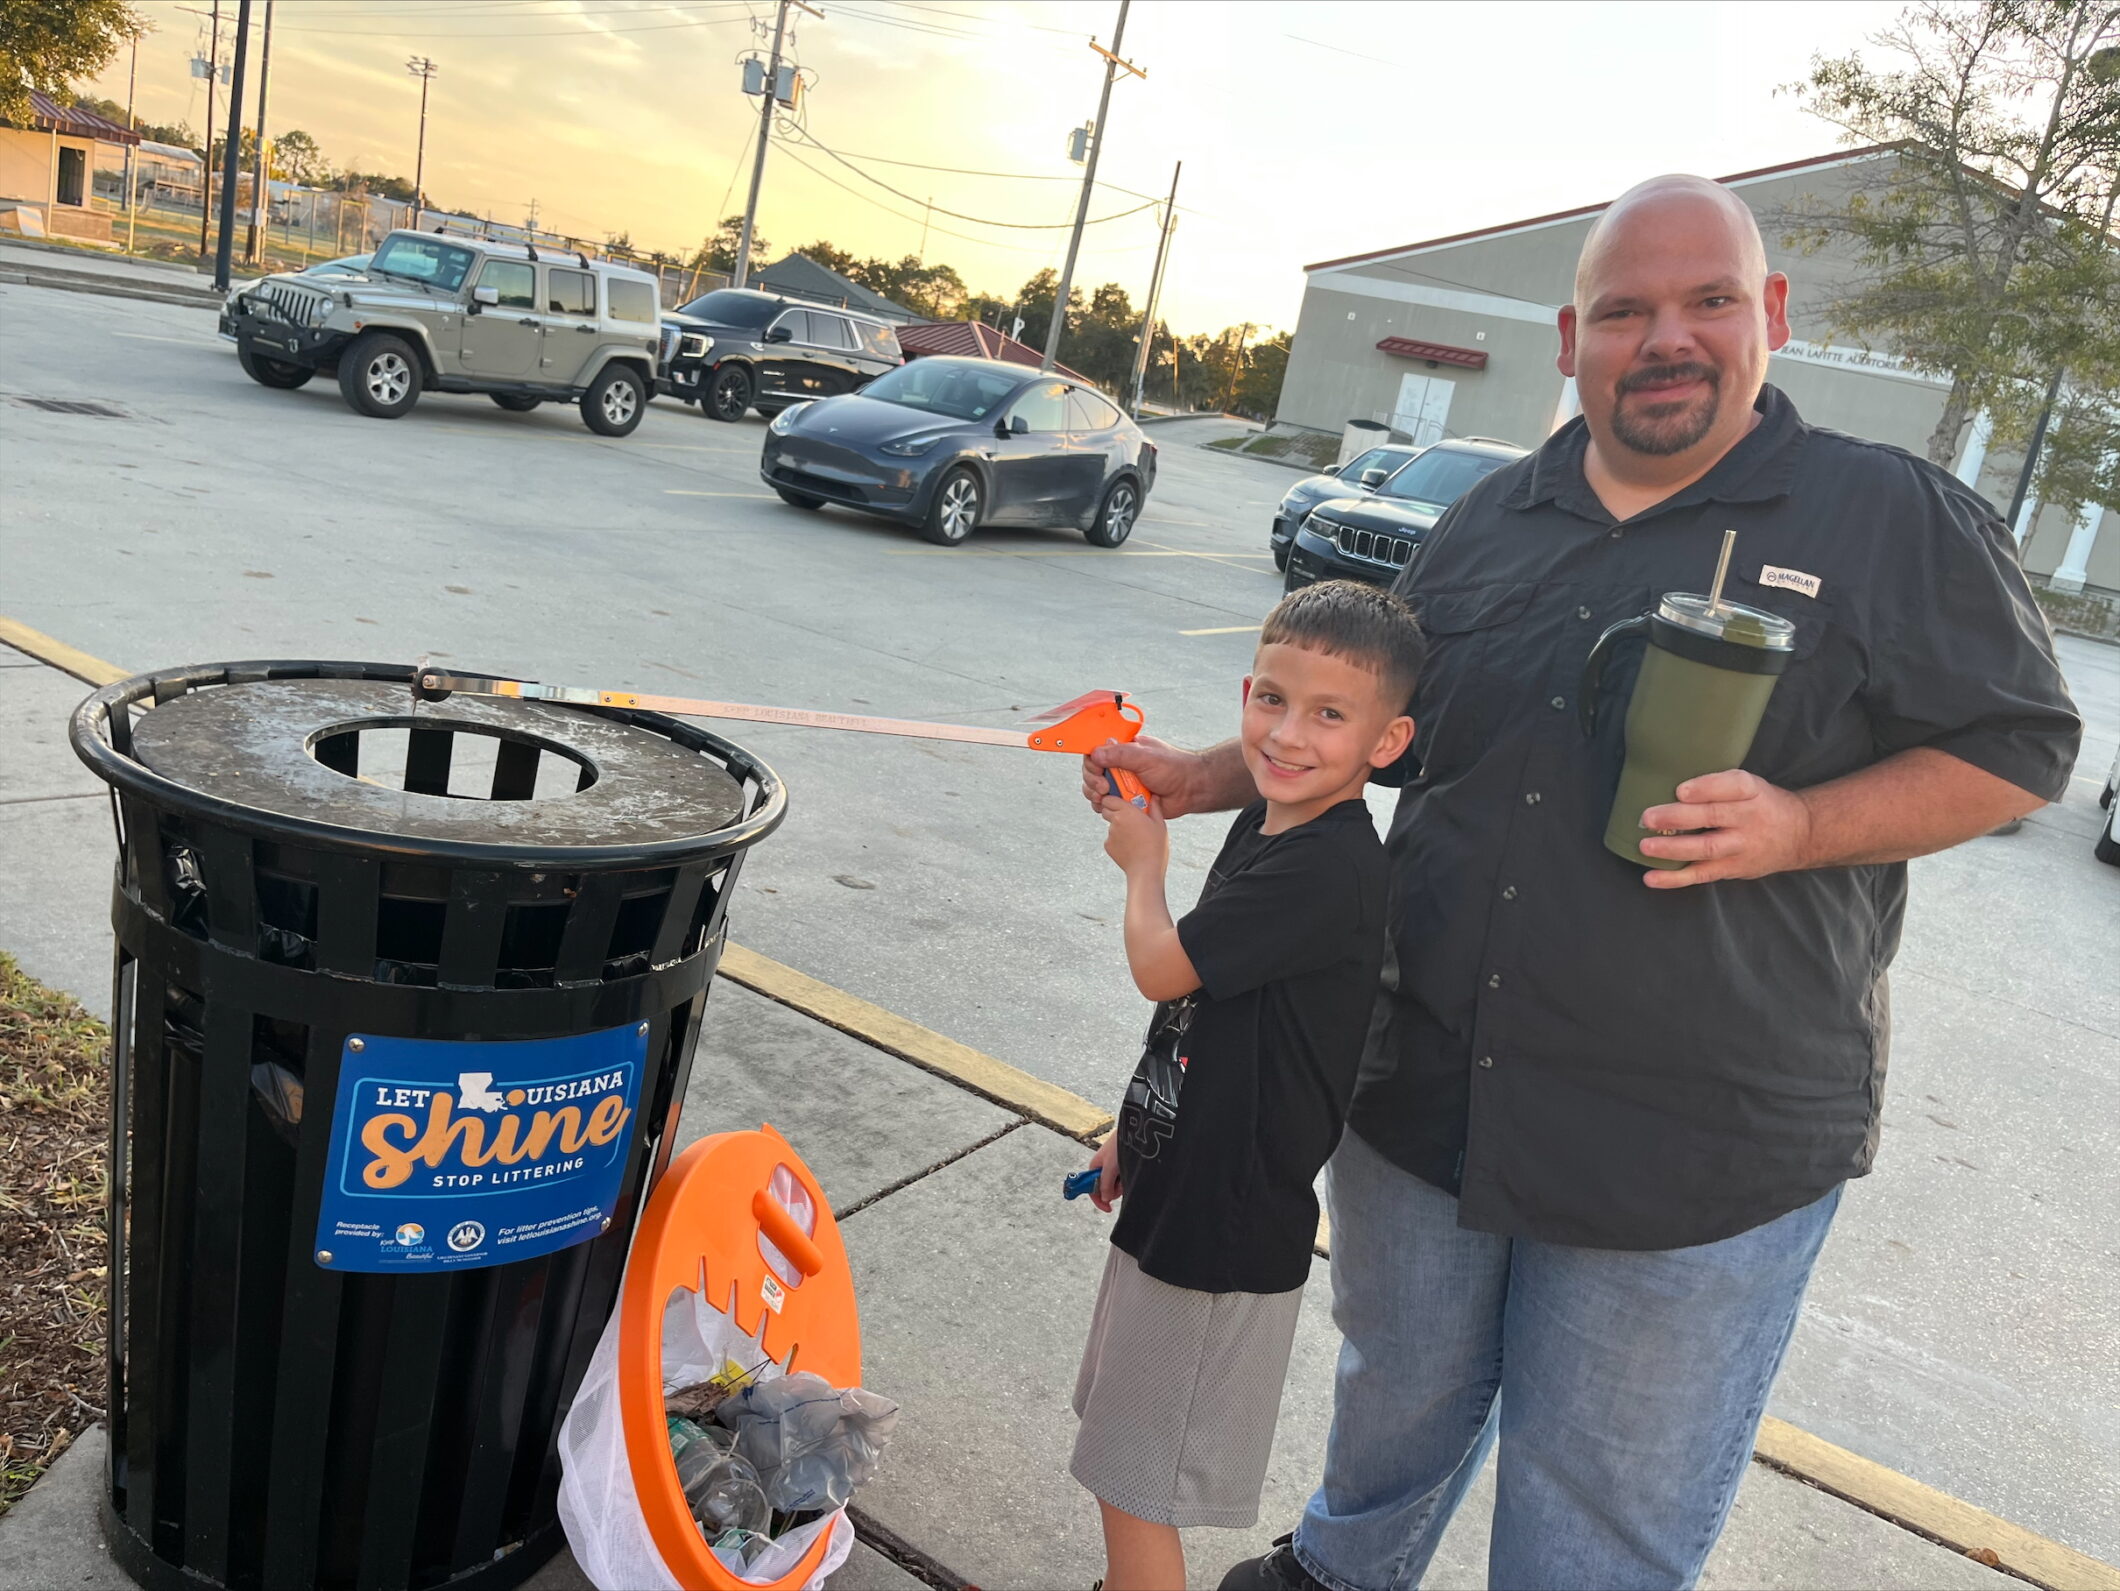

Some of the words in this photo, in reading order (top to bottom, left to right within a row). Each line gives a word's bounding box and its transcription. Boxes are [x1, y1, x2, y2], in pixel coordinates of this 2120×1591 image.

[1780, 346, 1803, 357] JEAN
[1807, 348, 1843, 363] LAFITTE
[1778, 572, 1815, 589] MAGELLAN
[376, 1087, 430, 1108] LET
[361, 1090, 632, 1189] shine
[433, 1174, 484, 1188] STOP
[491, 1157, 585, 1185] LITTERING
[336, 1221, 380, 1231] Receptacle
[498, 1227, 516, 1236] For
[516, 1223, 537, 1233] litter
[538, 1211, 582, 1229] prevention
[335, 1229, 370, 1238] provided
[497, 1235, 517, 1245] visit
[380, 1245, 433, 1253] LOUISIANA
